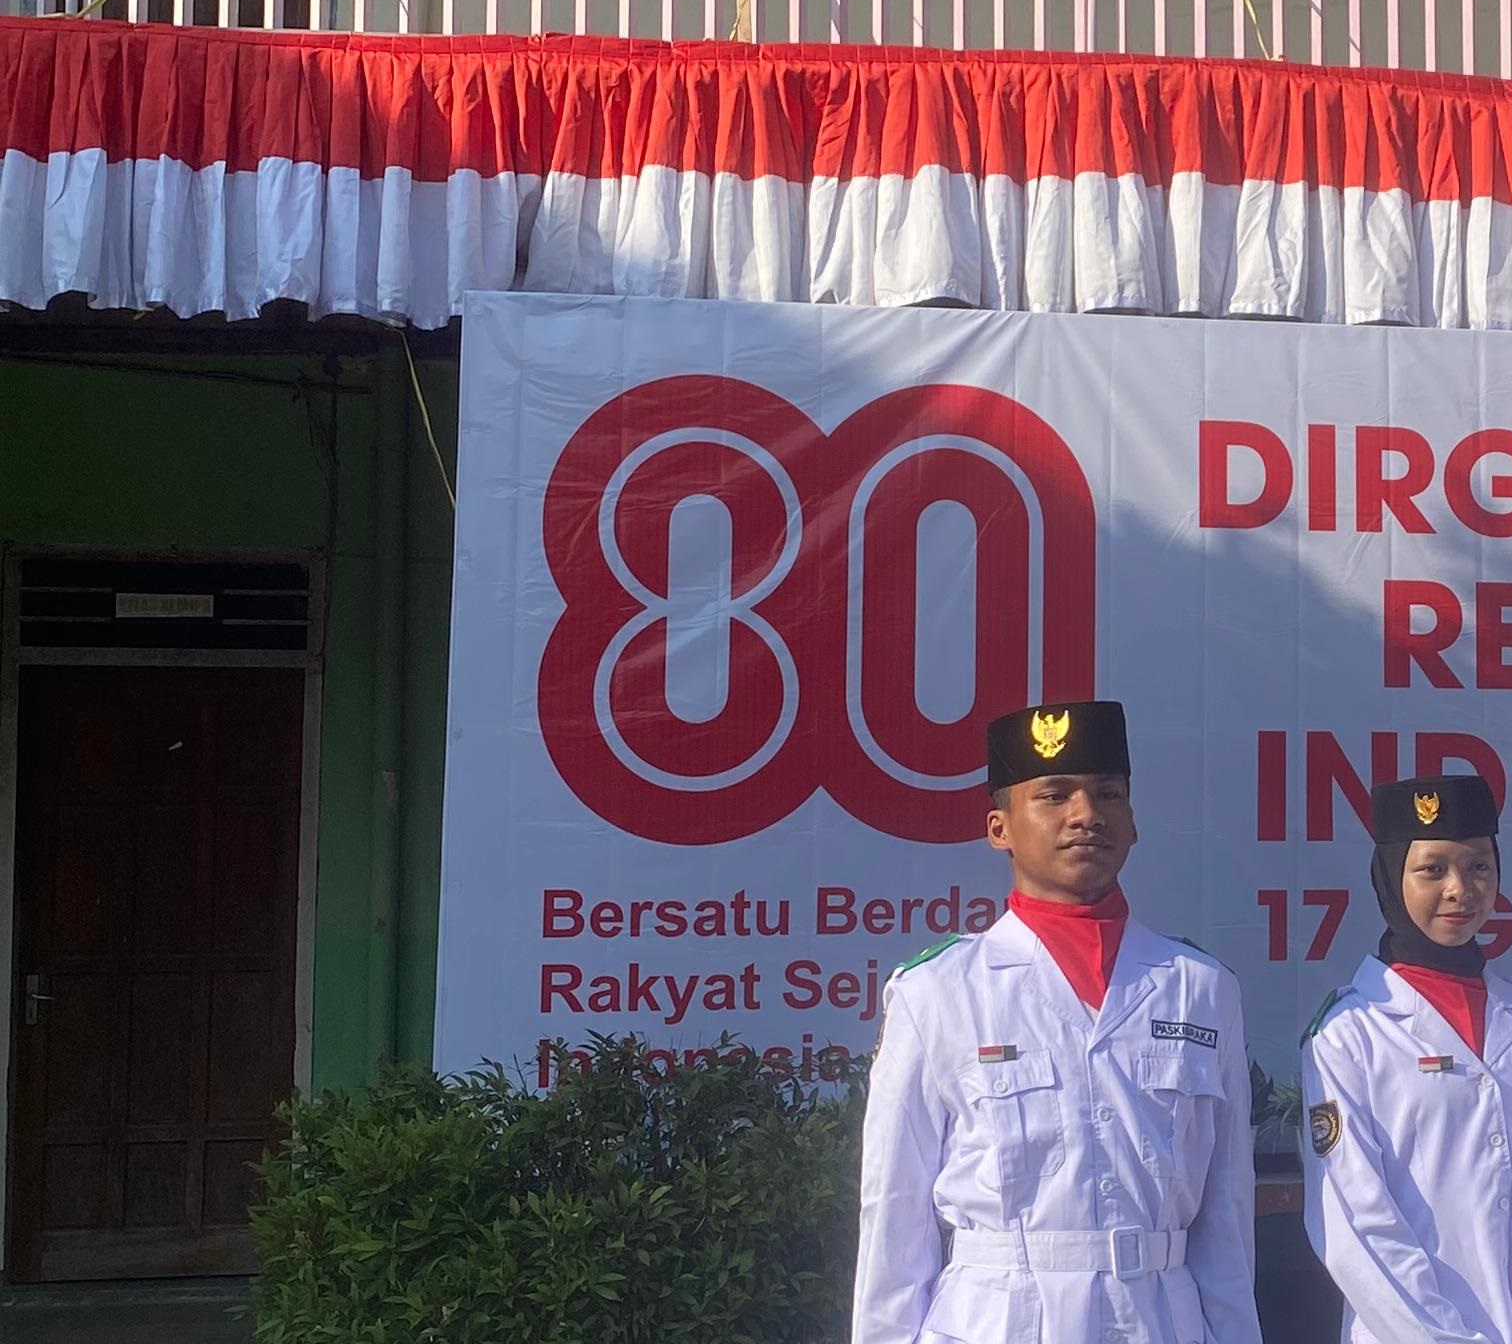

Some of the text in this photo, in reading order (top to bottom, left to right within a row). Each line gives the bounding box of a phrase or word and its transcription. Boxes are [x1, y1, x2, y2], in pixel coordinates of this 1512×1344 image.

[538, 374, 1097, 845] 80
[542, 885, 1008, 939] Bersatu Berda
[1257, 889, 1350, 962] 17
[539, 960, 879, 1025] Rakyat Sej
